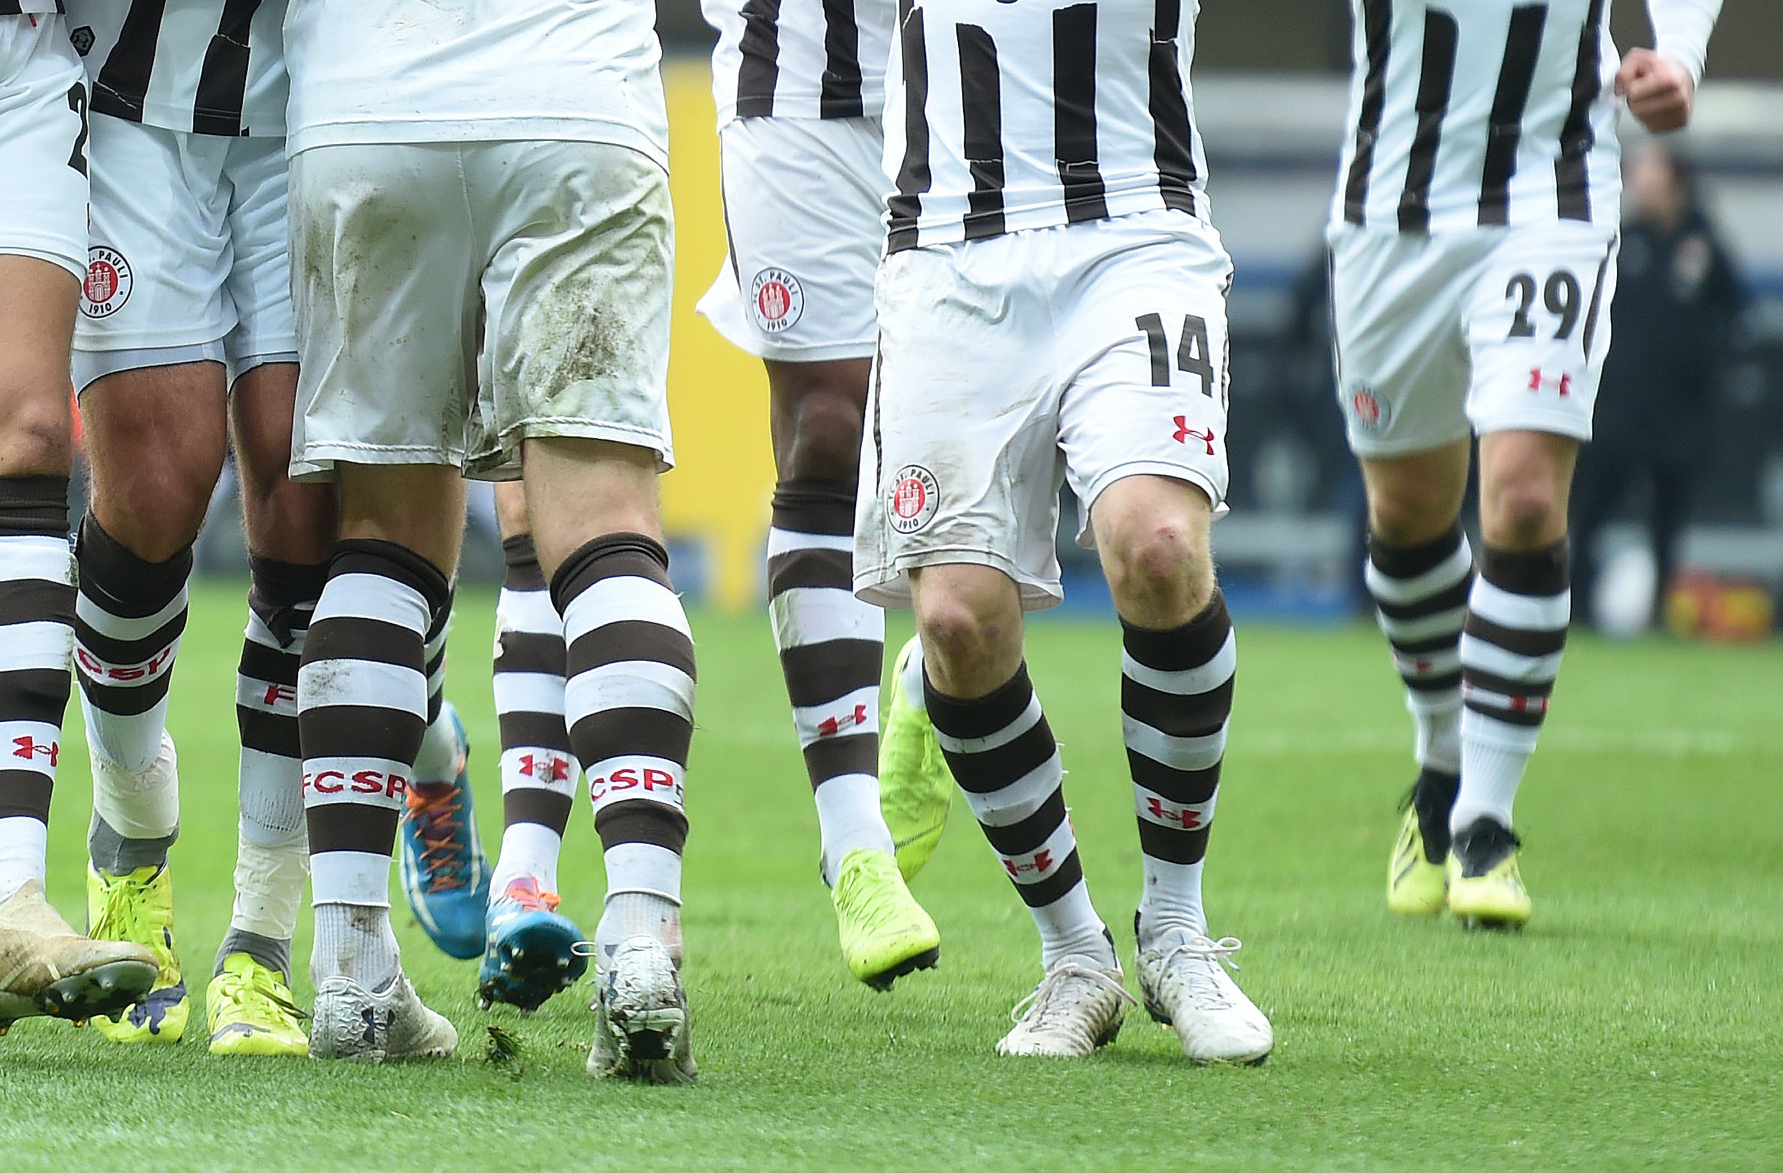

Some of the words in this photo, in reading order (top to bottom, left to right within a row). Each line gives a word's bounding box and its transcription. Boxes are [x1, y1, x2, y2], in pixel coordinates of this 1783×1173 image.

[98, 250, 128, 278] PAULI
[770, 271, 799, 295] PAULI
[89, 302, 112, 315] 1910
[1504, 271, 1581, 341] 29
[767, 318, 788, 331] 1910
[1135, 312, 1215, 399] 14
[911, 468, 935, 495] PAULI
[899, 518, 919, 530] 1910
